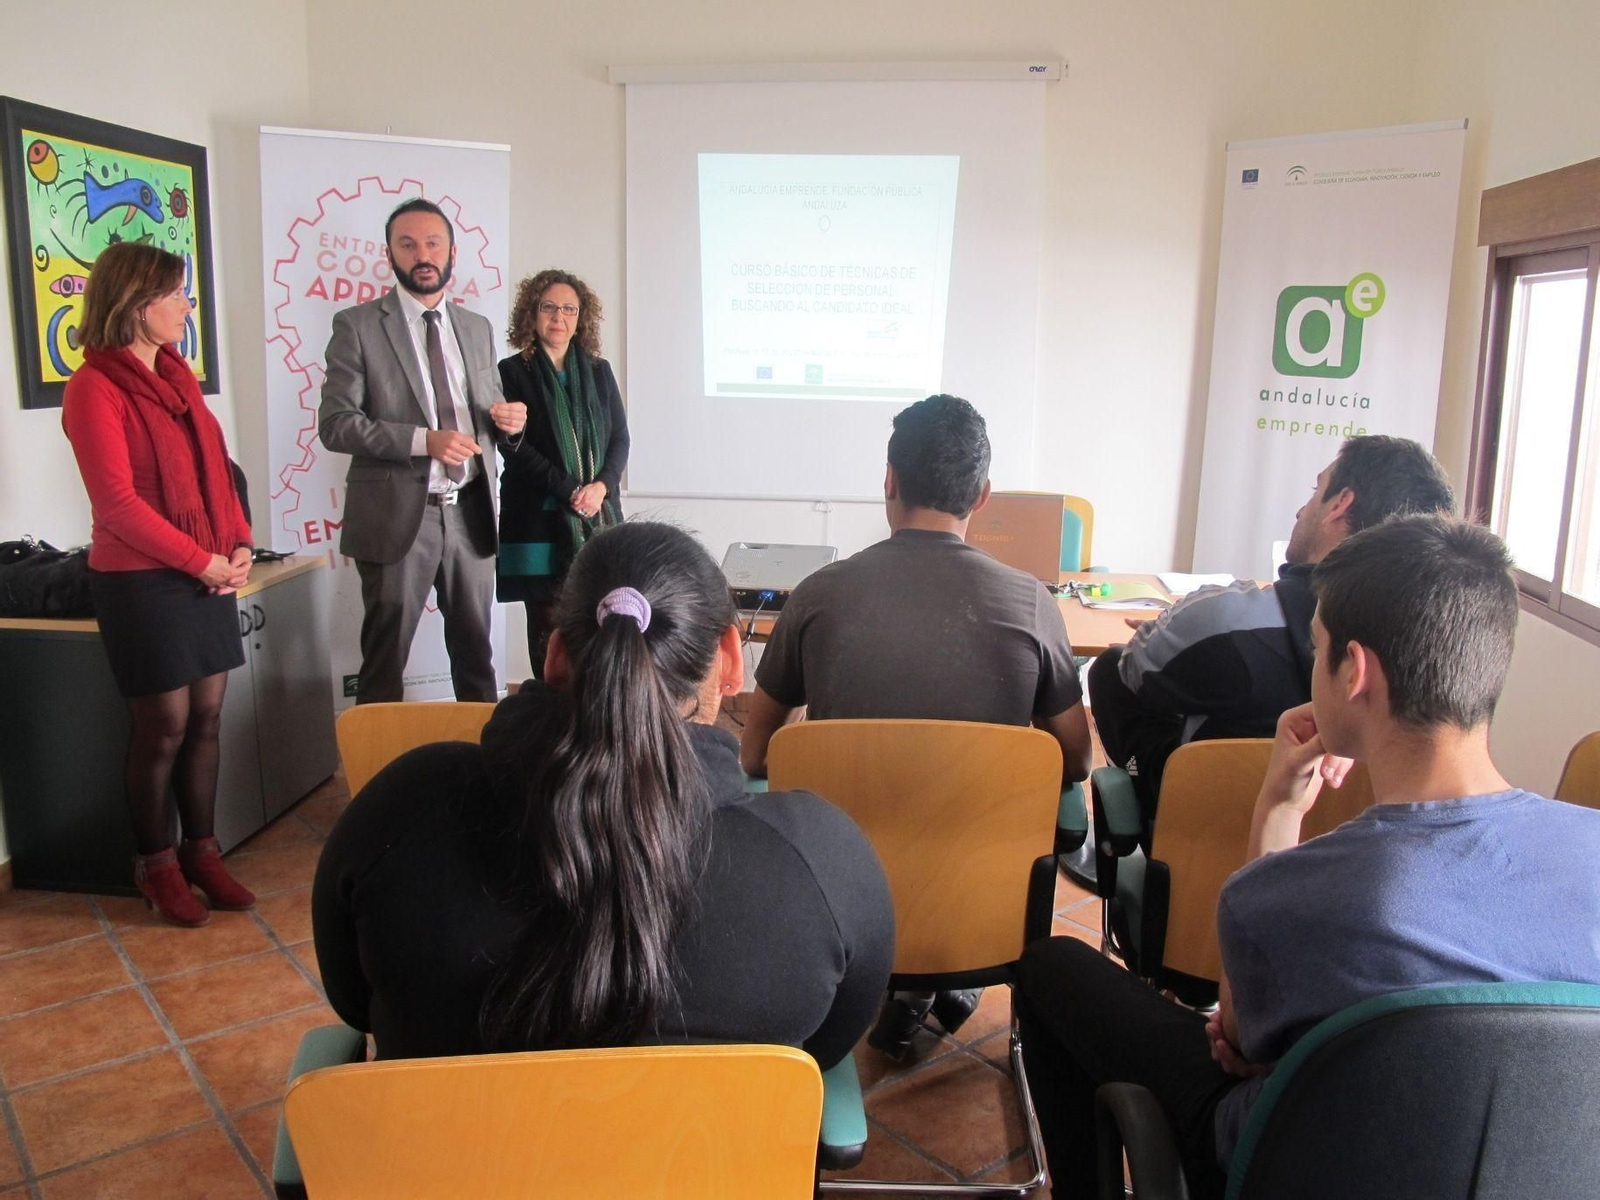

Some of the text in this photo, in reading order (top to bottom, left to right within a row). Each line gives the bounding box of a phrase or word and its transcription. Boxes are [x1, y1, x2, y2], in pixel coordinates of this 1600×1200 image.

[731, 263, 772, 277] CURSO
[774, 260, 818, 278] BÁSICO
[820, 265, 836, 278] DE
[900, 266, 917, 279] DE
[815, 283, 832, 296] DE
[833, 283, 895, 297] PERSONAL
[731, 298, 914, 315] BUSCANDO AL CANDIDATO IDEAL
[1259, 386, 1371, 410] andalucía
[1256, 418, 1368, 440] emprende
